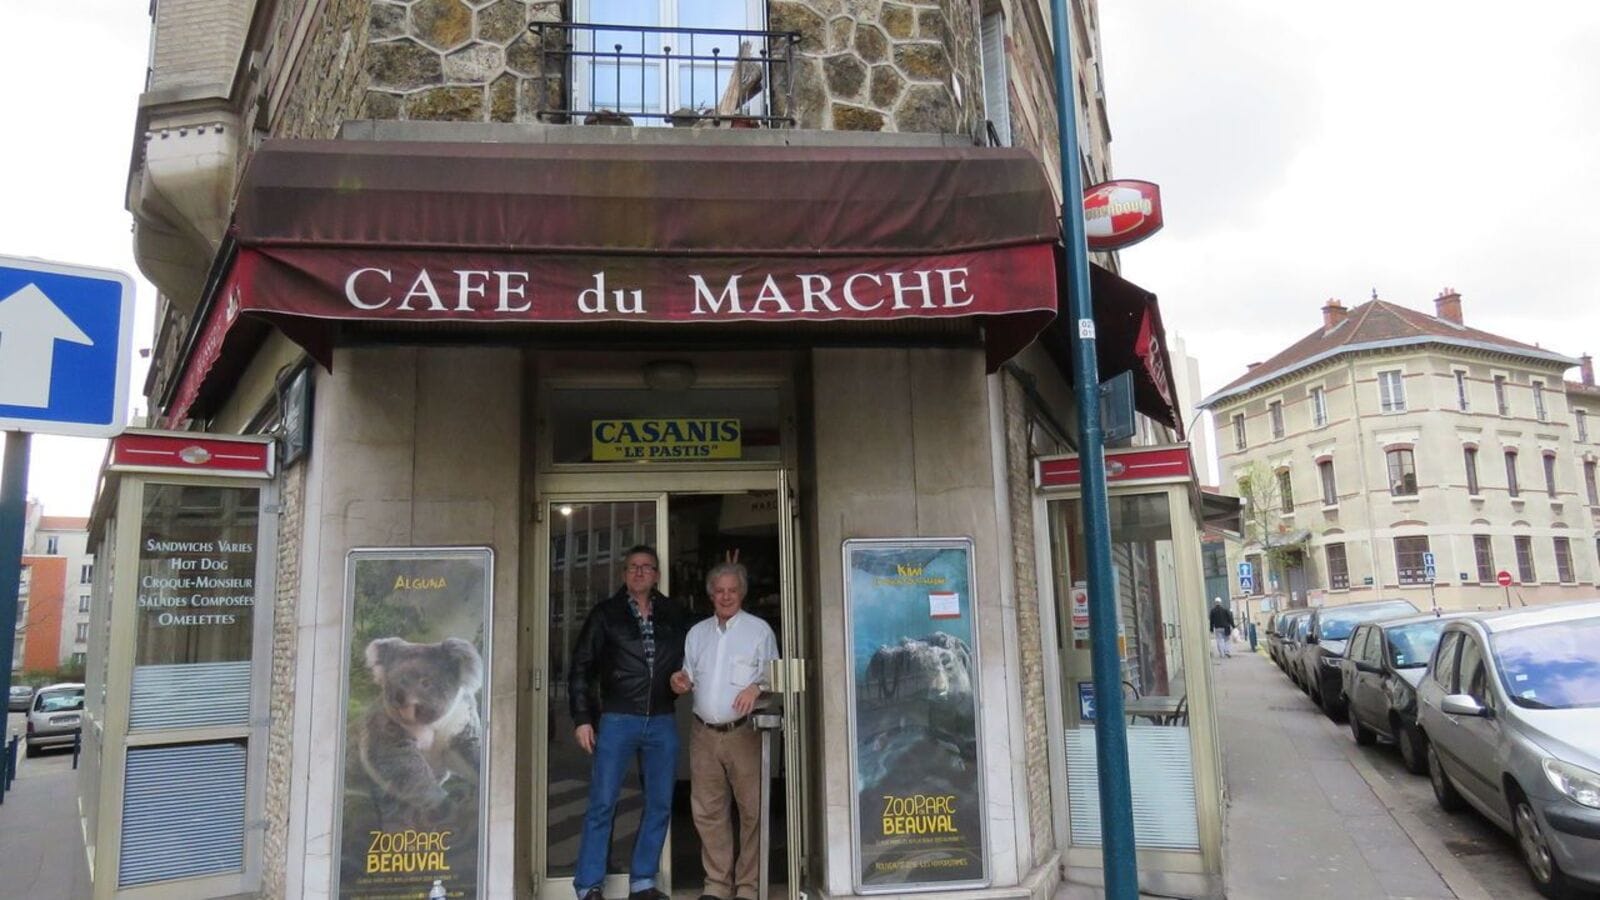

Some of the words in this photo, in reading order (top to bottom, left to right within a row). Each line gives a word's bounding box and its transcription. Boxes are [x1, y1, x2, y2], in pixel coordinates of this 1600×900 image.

[345, 267, 532, 312] CAFE
[577, 271, 647, 313] du
[688, 267, 974, 314] MARCHE
[595, 421, 739, 443] CASANIS
[615, 445, 645, 458] "LE
[649, 444, 719, 457] PASTIS"
[146, 538, 214, 552] SANDWICHS
[170, 557, 197, 570] HOT
[200, 558, 228, 570] DOG
[143, 576, 253, 589] CROQUE-MONSIEUR
[139, 594, 187, 606] SALADES
[159, 613, 235, 625] OMELETTES
[883, 794, 956, 816] ZOOPARC
[883, 816, 957, 834] BEAUVAL
[367, 830, 452, 853] ZOOPARC
[367, 852, 450, 873] BEAUVAL
